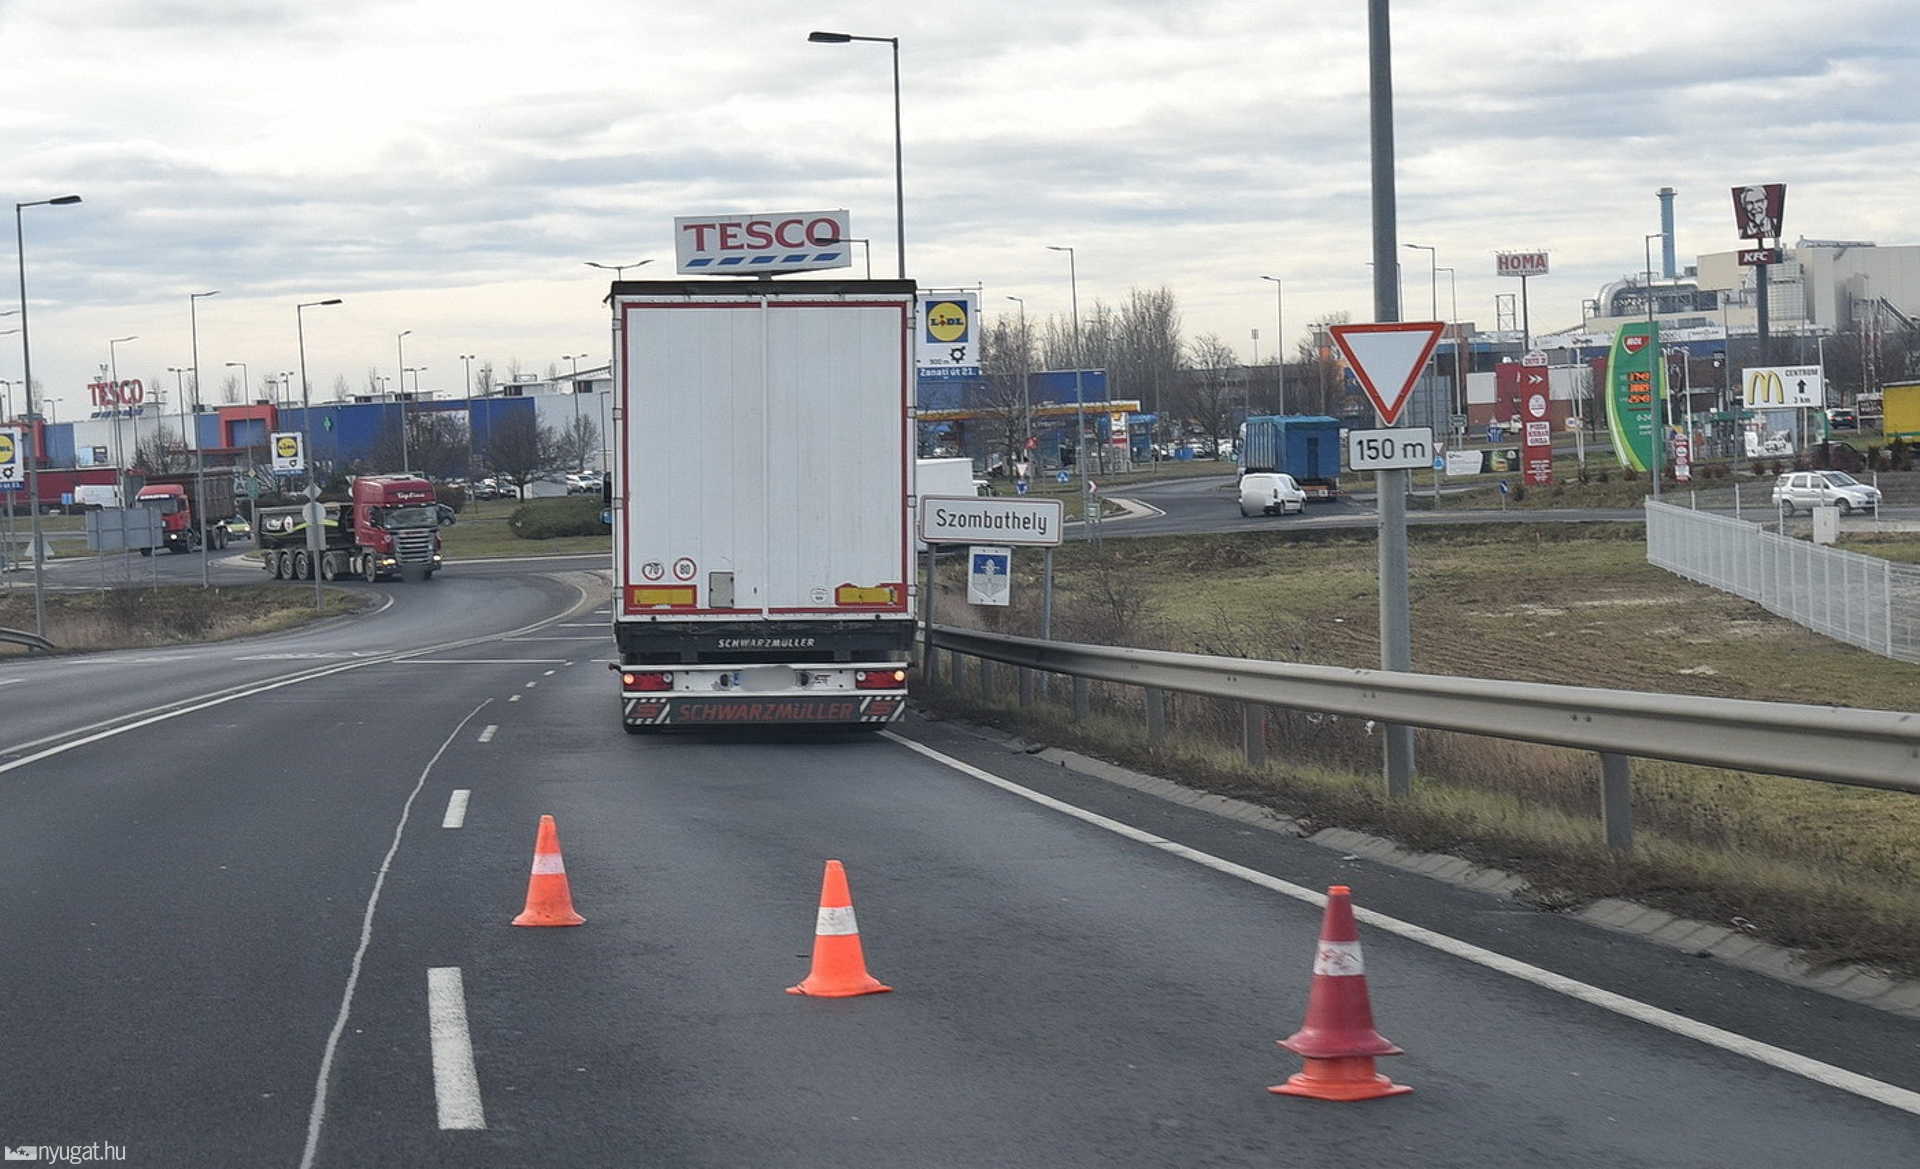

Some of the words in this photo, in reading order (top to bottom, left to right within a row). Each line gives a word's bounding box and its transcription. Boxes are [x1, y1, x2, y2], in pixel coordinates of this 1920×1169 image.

[683, 217, 841, 252] TESCO
[1498, 254, 1547, 270] HOMA
[1743, 251, 1769, 262] KFC
[1785, 368, 1818, 377] CENTRUM
[87, 379, 144, 407] TESCO
[1357, 438, 1394, 460] 150
[1402, 442, 1425, 458] m
[936, 508, 1048, 535] Szombathely
